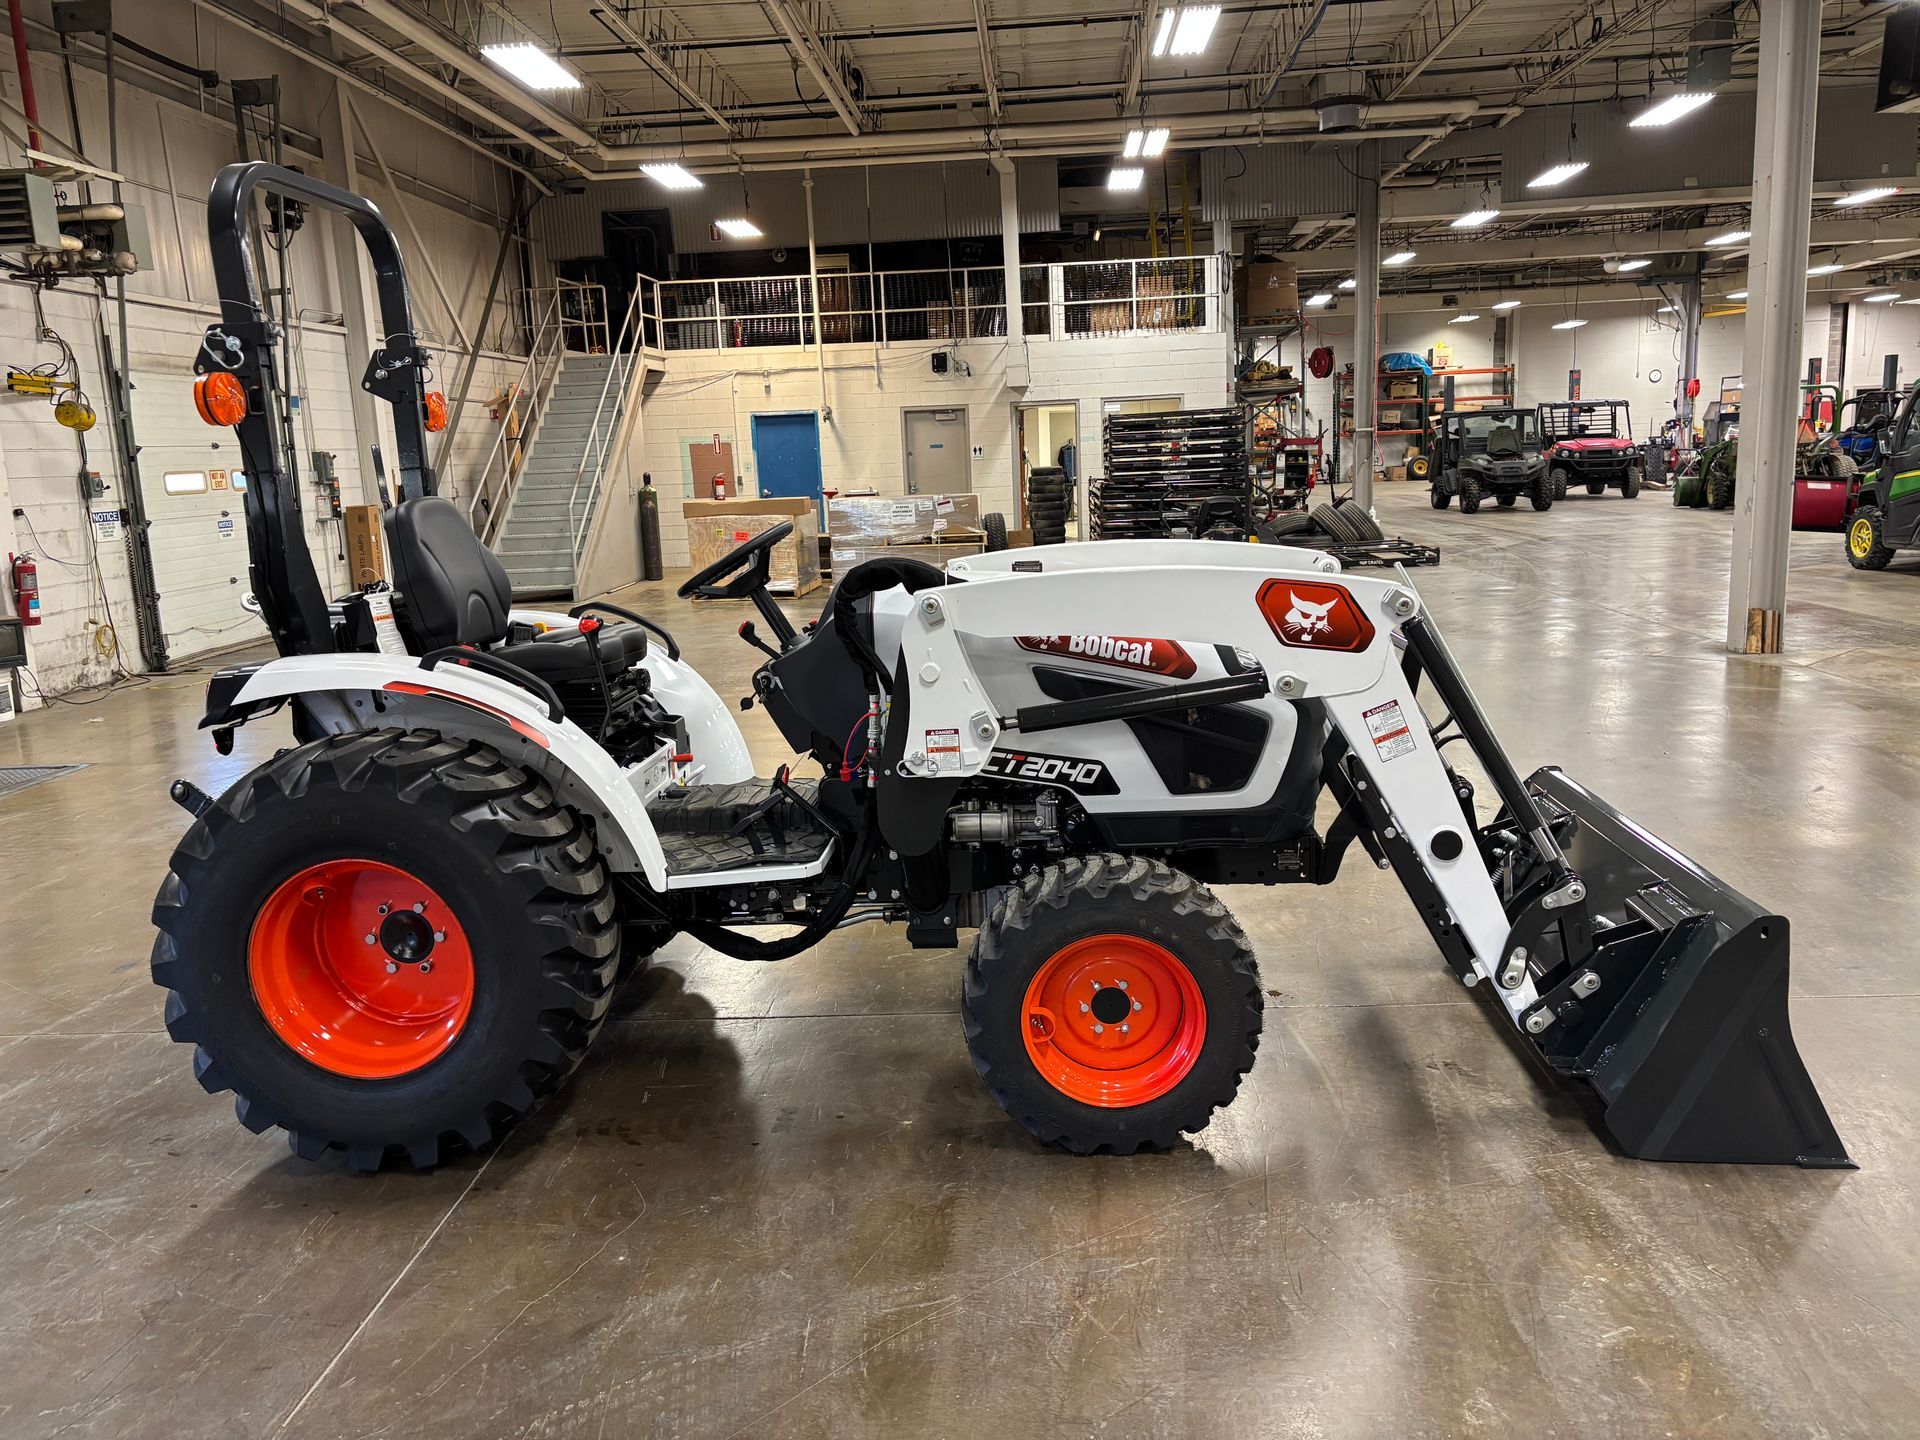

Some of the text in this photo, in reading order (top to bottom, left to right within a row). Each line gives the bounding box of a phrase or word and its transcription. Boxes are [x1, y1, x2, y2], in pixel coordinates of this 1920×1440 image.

[214, 480, 224, 488] EXIT
[92, 512, 118, 522] NOTICE
[357, 534, 366, 556] LAMPS
[1068, 636, 1153, 666] Bobcat
[1371, 701, 1396, 715] DANGER
[1381, 729, 1406, 740] WARNING
[984, 751, 1102, 784] CT2040
